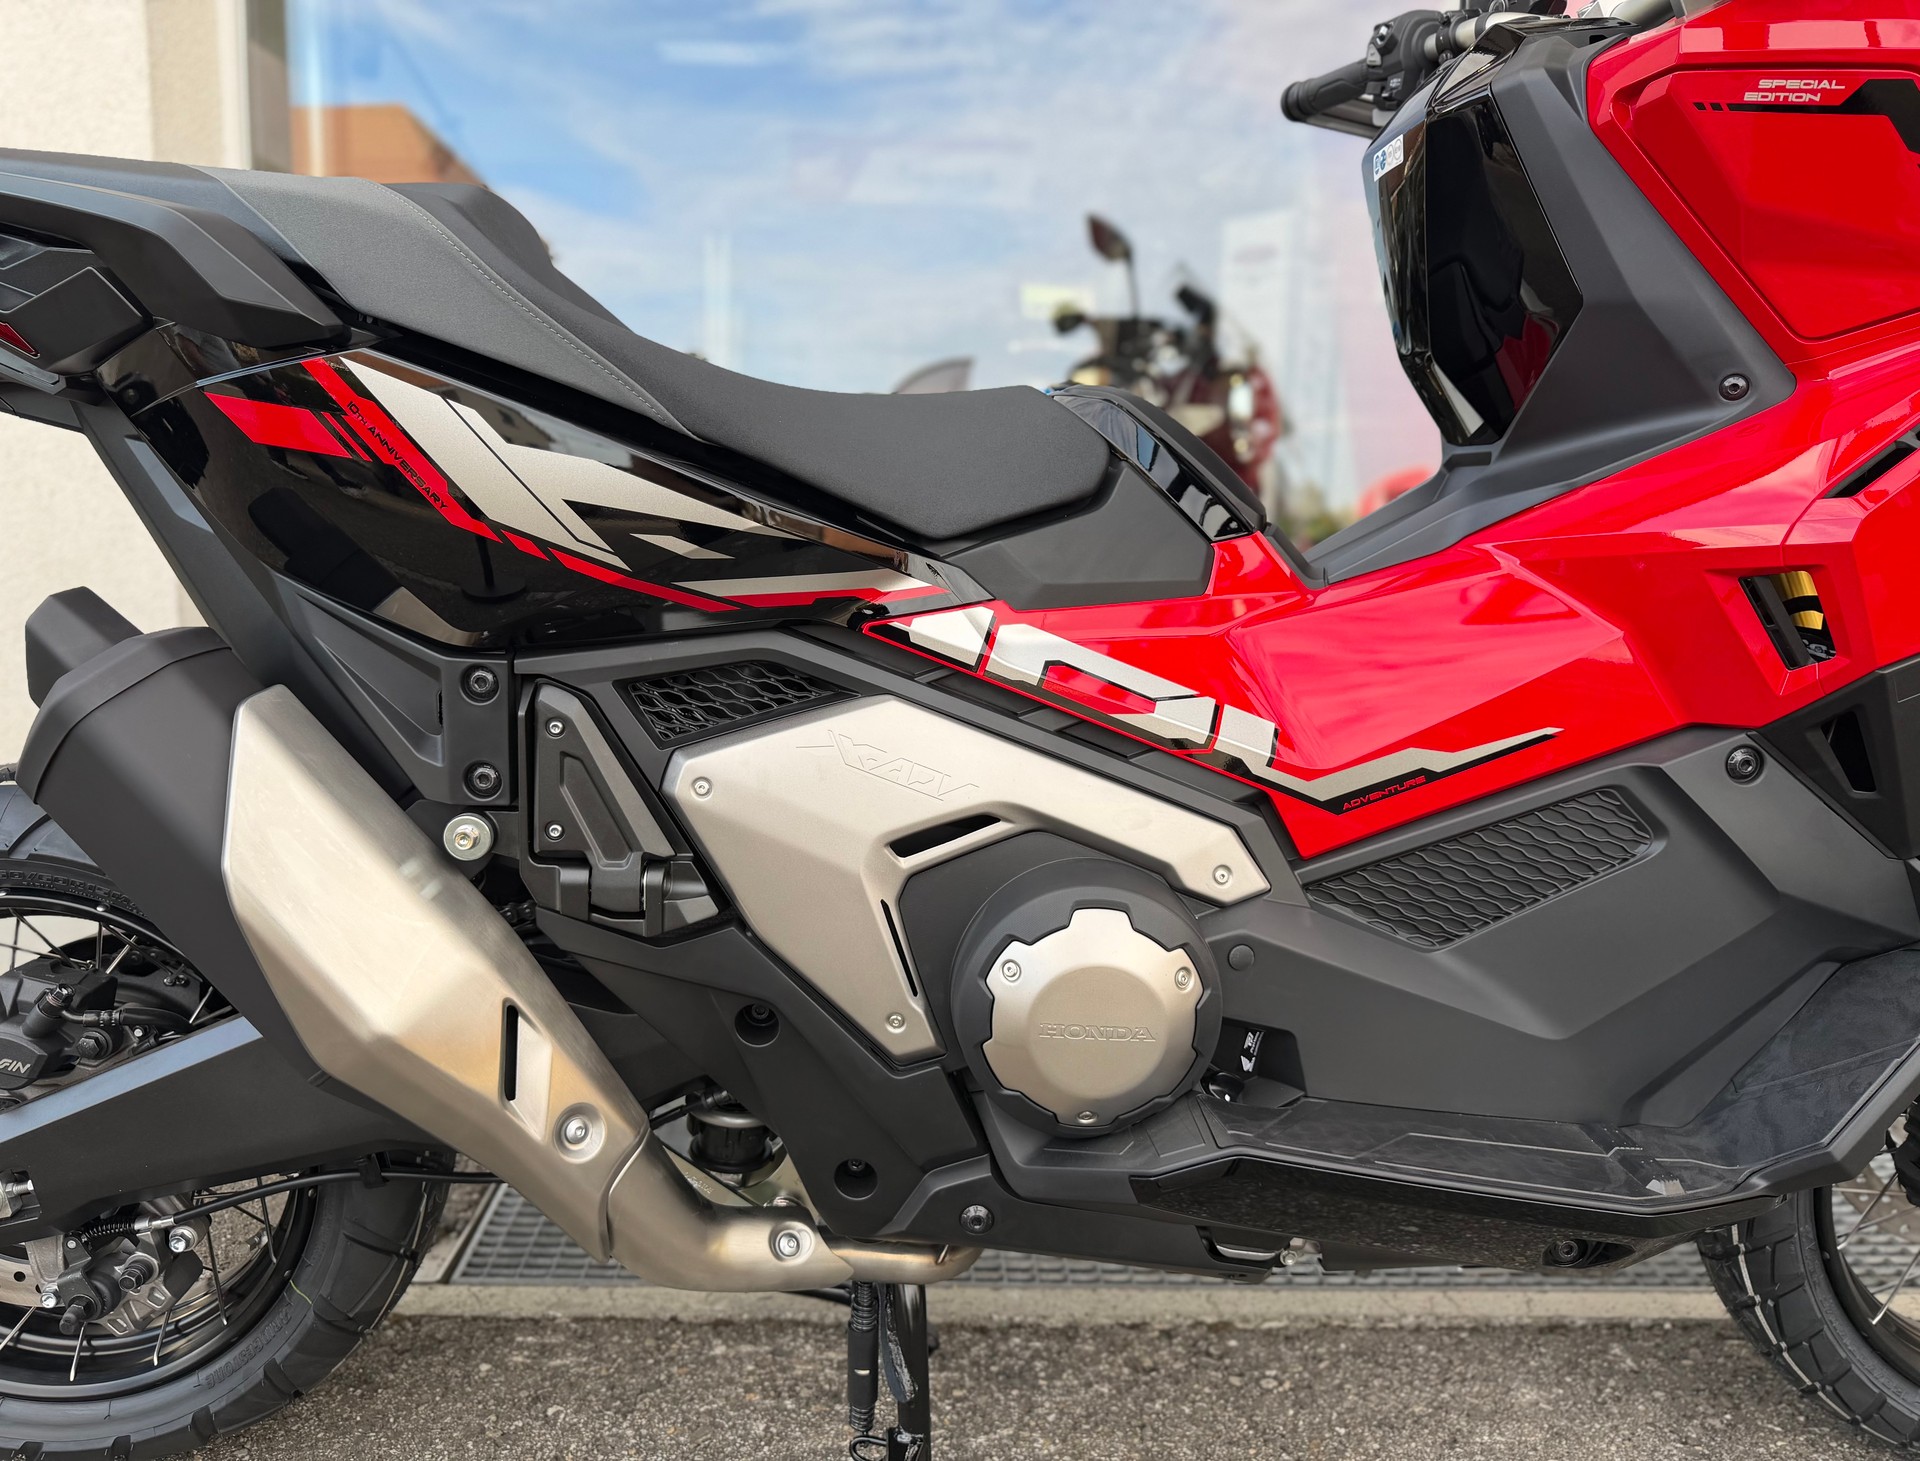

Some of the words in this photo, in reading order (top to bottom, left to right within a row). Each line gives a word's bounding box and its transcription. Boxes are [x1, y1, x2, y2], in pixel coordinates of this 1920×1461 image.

[1758, 79, 1846, 90] SPECIAL
[1743, 92, 1822, 103] EDITION
[368, 427, 450, 510] ANNIVERSARY
[1342, 775, 1428, 811] ADVENTURE
[1038, 1023, 1157, 1043] HONDA
